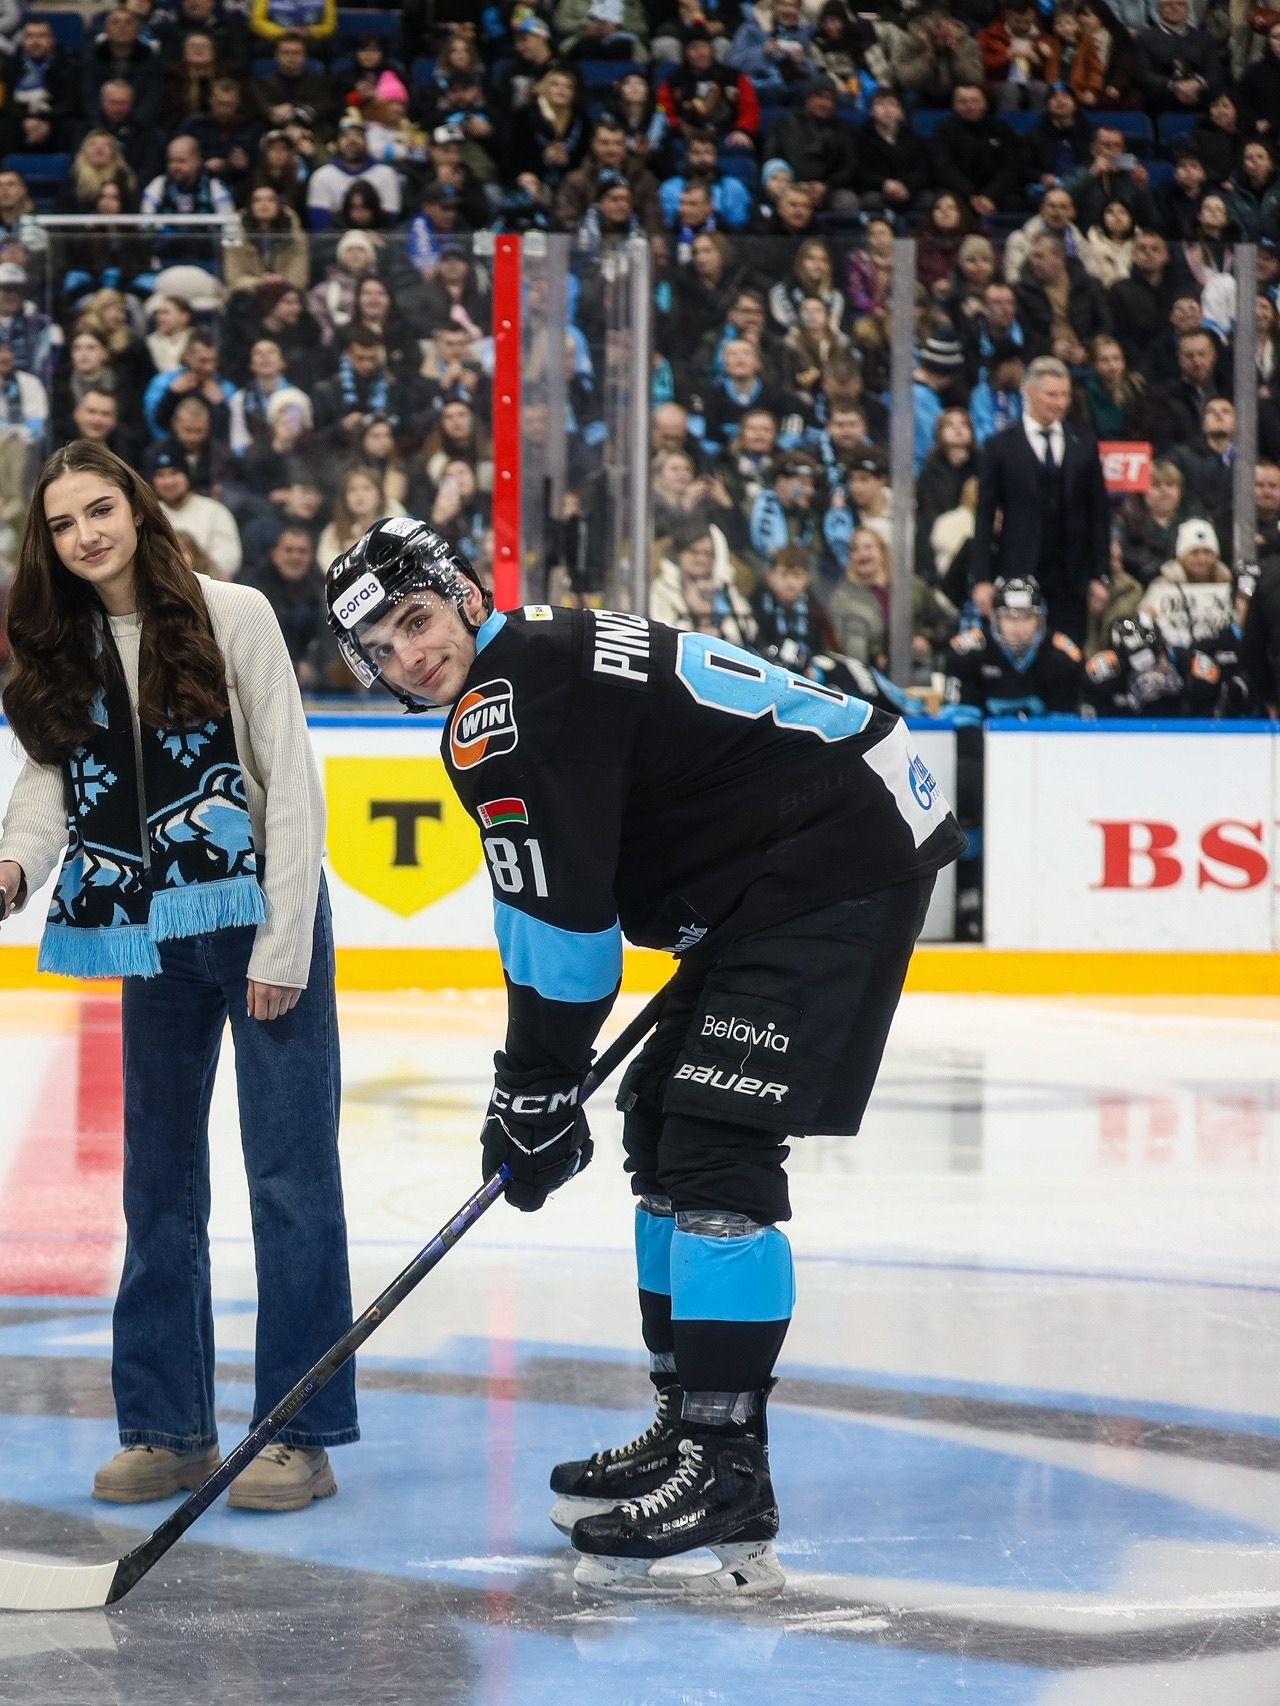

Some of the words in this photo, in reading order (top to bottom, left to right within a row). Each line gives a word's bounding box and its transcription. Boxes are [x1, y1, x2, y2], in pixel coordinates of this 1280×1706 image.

[462, 702, 507, 740] WIN
[483, 837, 549, 897] 81
[1088, 819, 1280, 891] BS
[701, 1015, 790, 1053] Belavia
[491, 1084, 579, 1114] CCM
